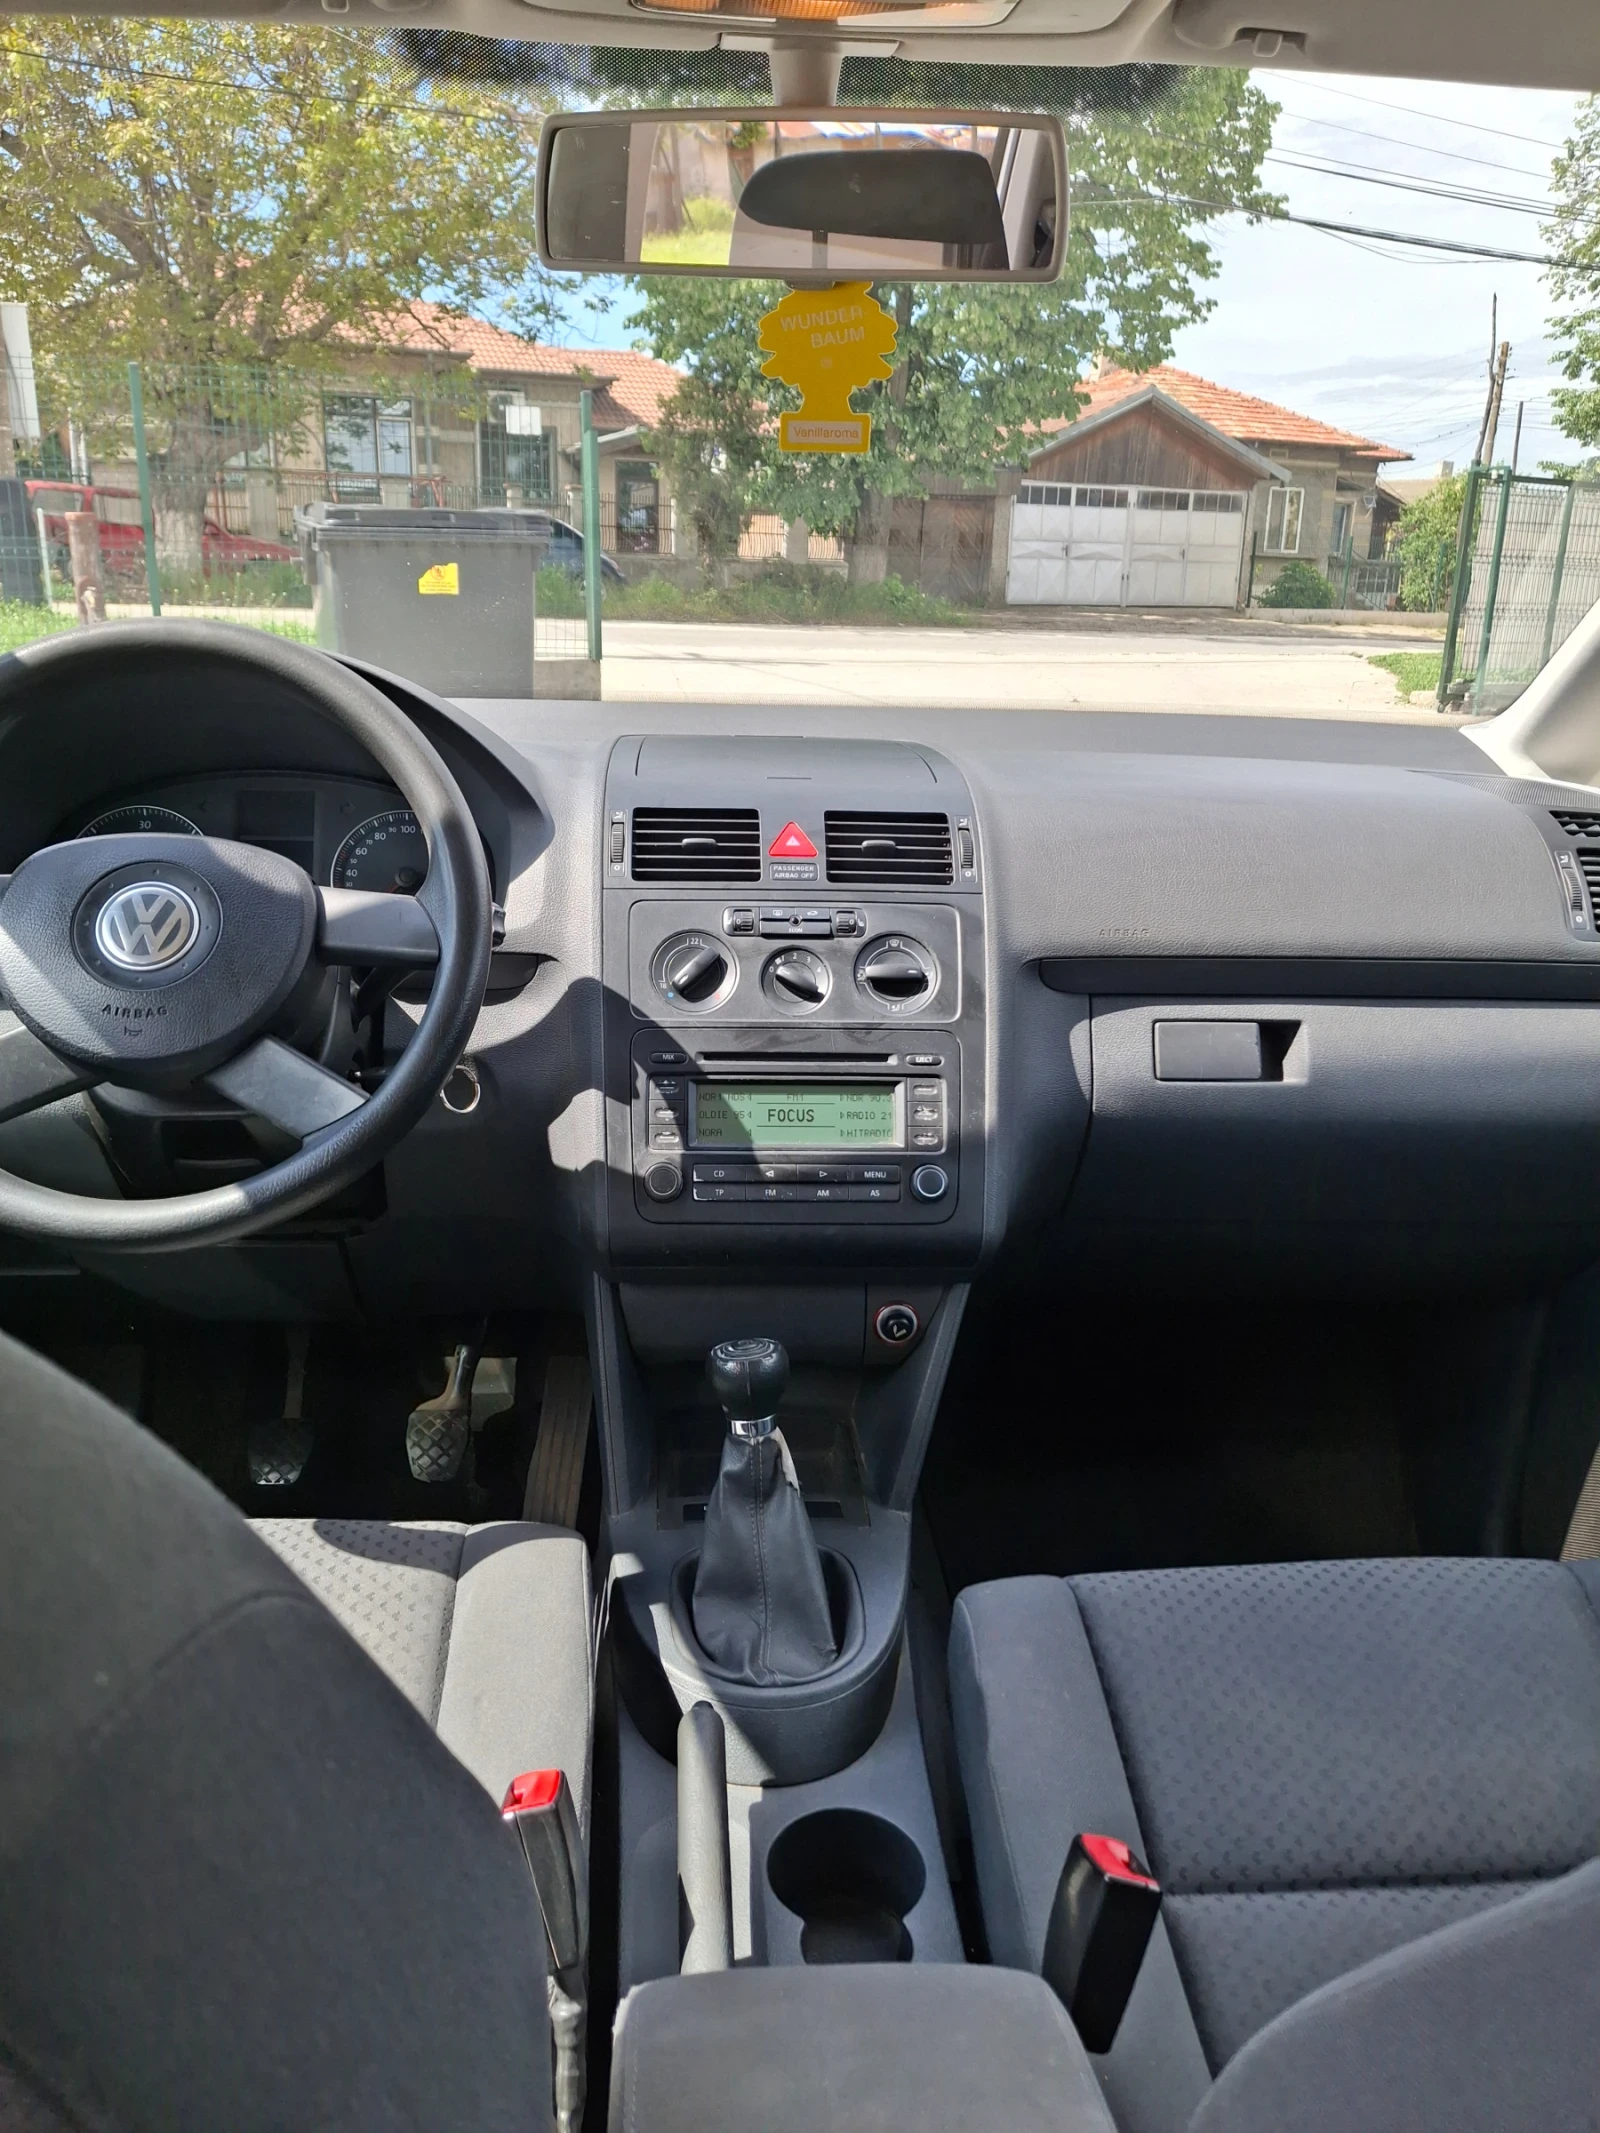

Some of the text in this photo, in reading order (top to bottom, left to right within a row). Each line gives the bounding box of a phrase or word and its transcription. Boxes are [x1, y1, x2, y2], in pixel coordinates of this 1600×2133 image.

[810, 326, 865, 348] BAUM
[793, 426, 859, 439] Vanillaroma
[139, 820, 152, 829] 30
[400, 825, 416, 834] 100
[374, 832, 387, 840] 80
[355, 847, 368, 855] 60
[345, 869, 358, 877] 40
[1099, 928, 1149, 937] AIRBAG
[792, 952, 798, 960] 2
[102, 1004, 168, 1019] AIRBAG
[699, 1110, 728, 1119] OLDIE
[767, 1108, 815, 1123] FOCUS
[846, 1111, 892, 1120] RADIO 21
[699, 1128, 723, 1137] NORA
[713, 1169, 725, 1178] CD
[864, 1170, 887, 1179] MENU
[715, 1188, 724, 1196] TP
[816, 1189, 830, 1197] AM
[870, 1189, 880, 1197] AS
